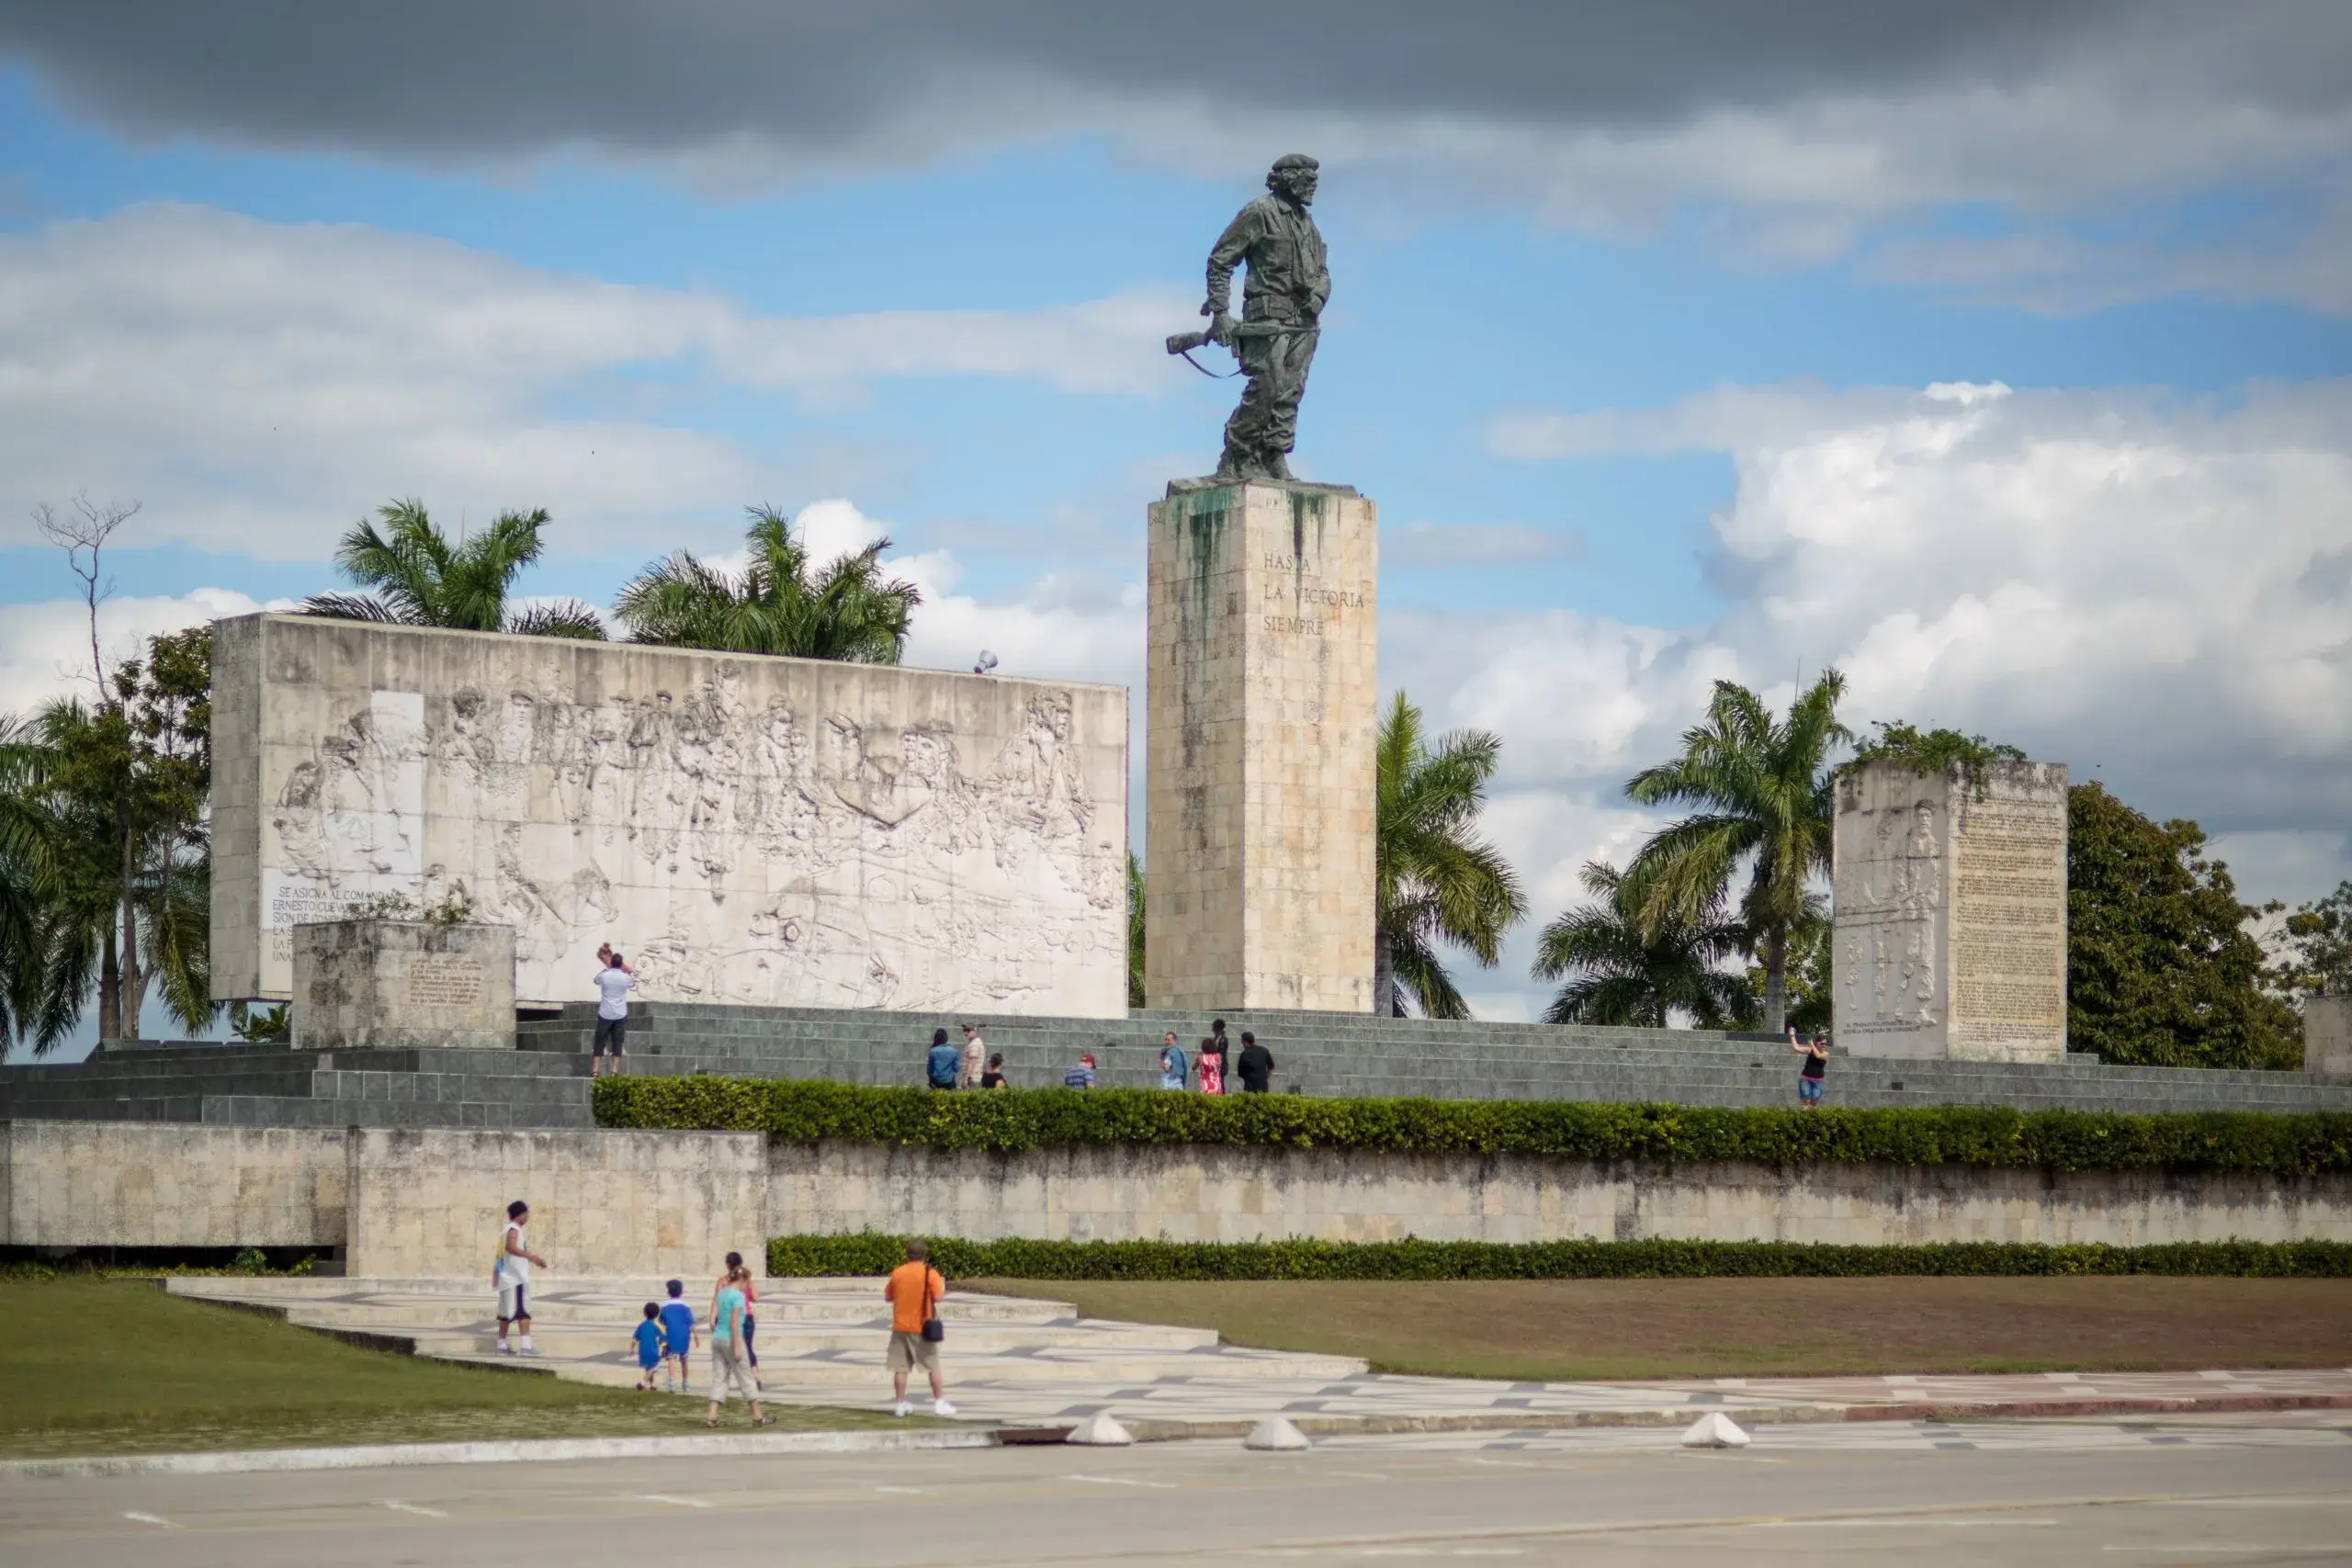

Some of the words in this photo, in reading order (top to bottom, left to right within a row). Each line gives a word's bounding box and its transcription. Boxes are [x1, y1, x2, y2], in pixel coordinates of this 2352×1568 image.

[1264, 583, 1283, 600] LA
[1295, 587, 1364, 608] VICTORIA
[1264, 615, 1323, 636] SIEMPRE
[279, 886, 291, 897] SE
[330, 889, 342, 900] AL
[272, 899, 316, 911] ERNESTO
[273, 925, 285, 936] LA
[273, 938, 285, 950] LA
